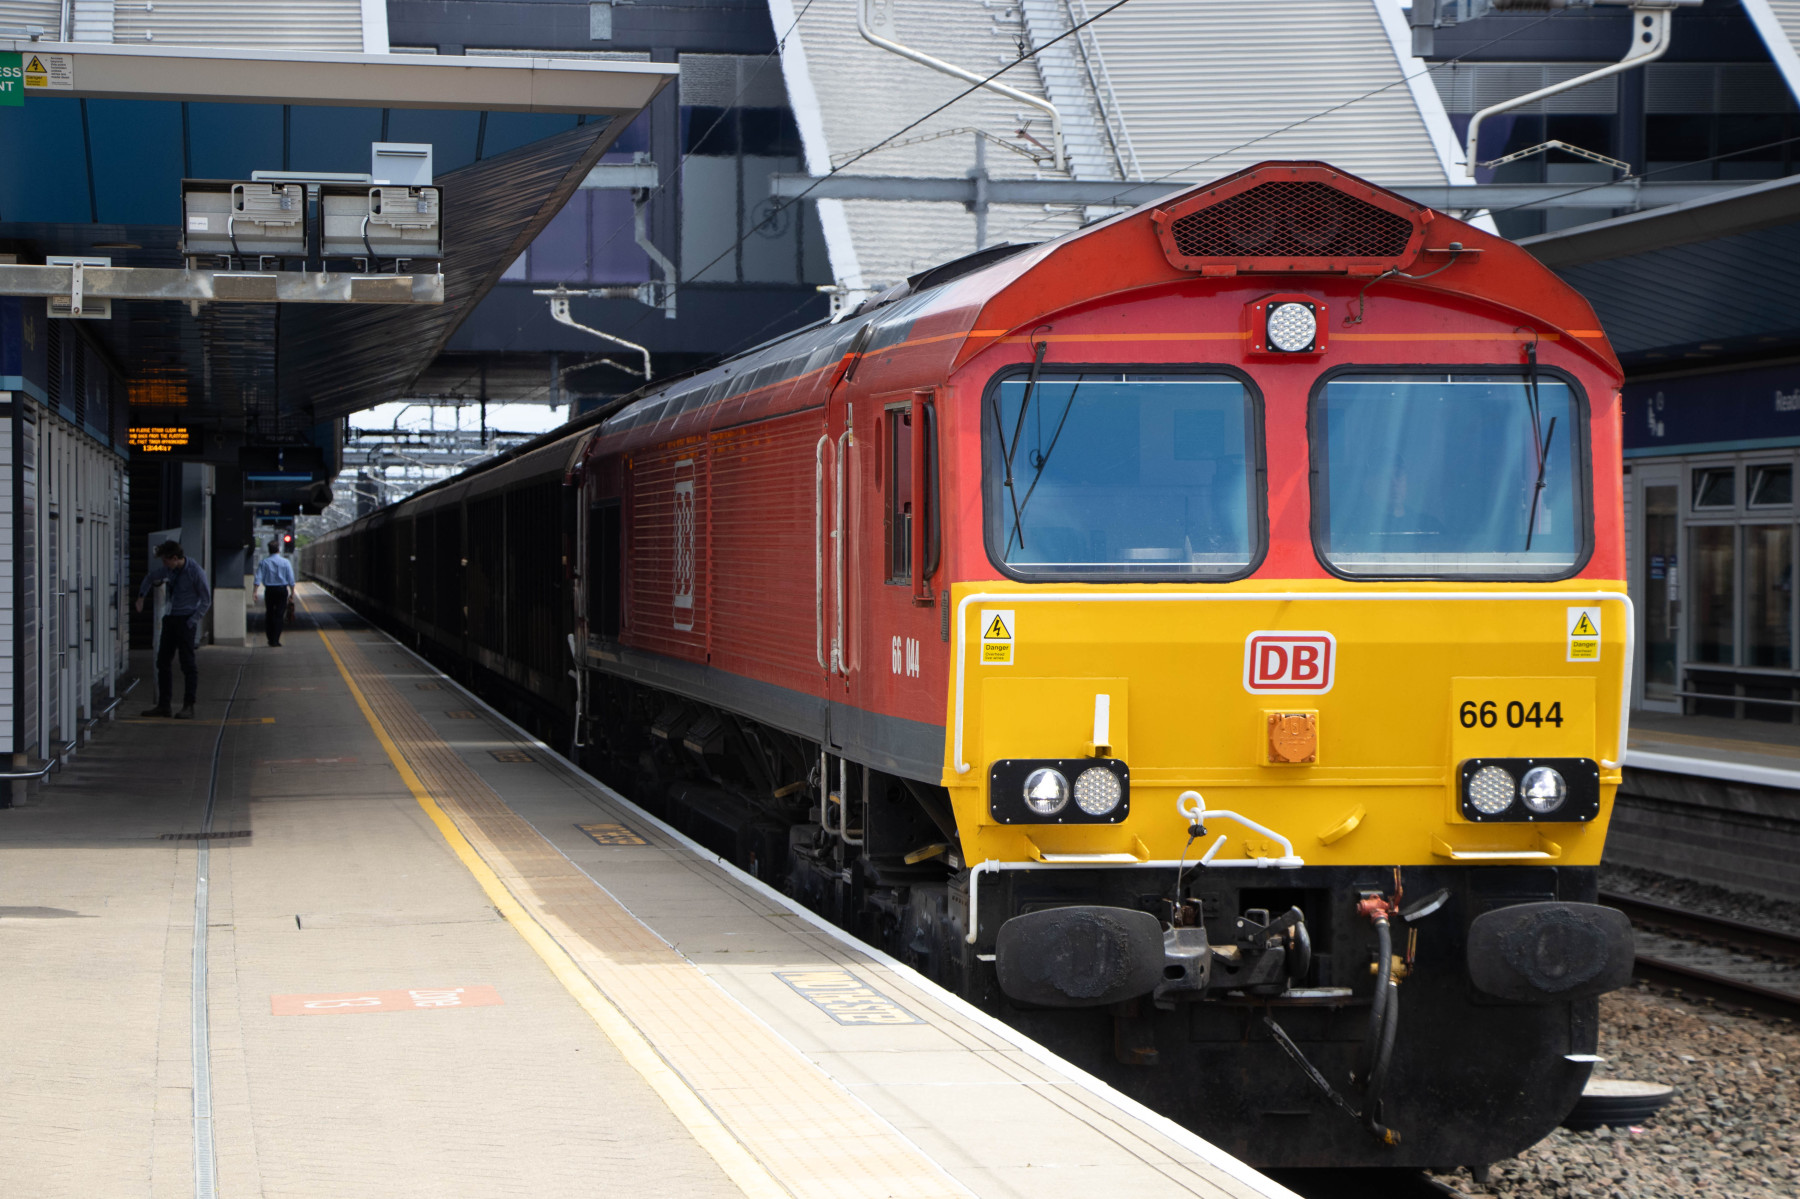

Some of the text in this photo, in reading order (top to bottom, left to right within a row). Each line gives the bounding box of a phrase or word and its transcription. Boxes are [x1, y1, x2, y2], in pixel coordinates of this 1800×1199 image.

[892, 635, 919, 678] 66 044
[1259, 645, 1319, 680] DB
[1459, 700, 1564, 728] 66 044
